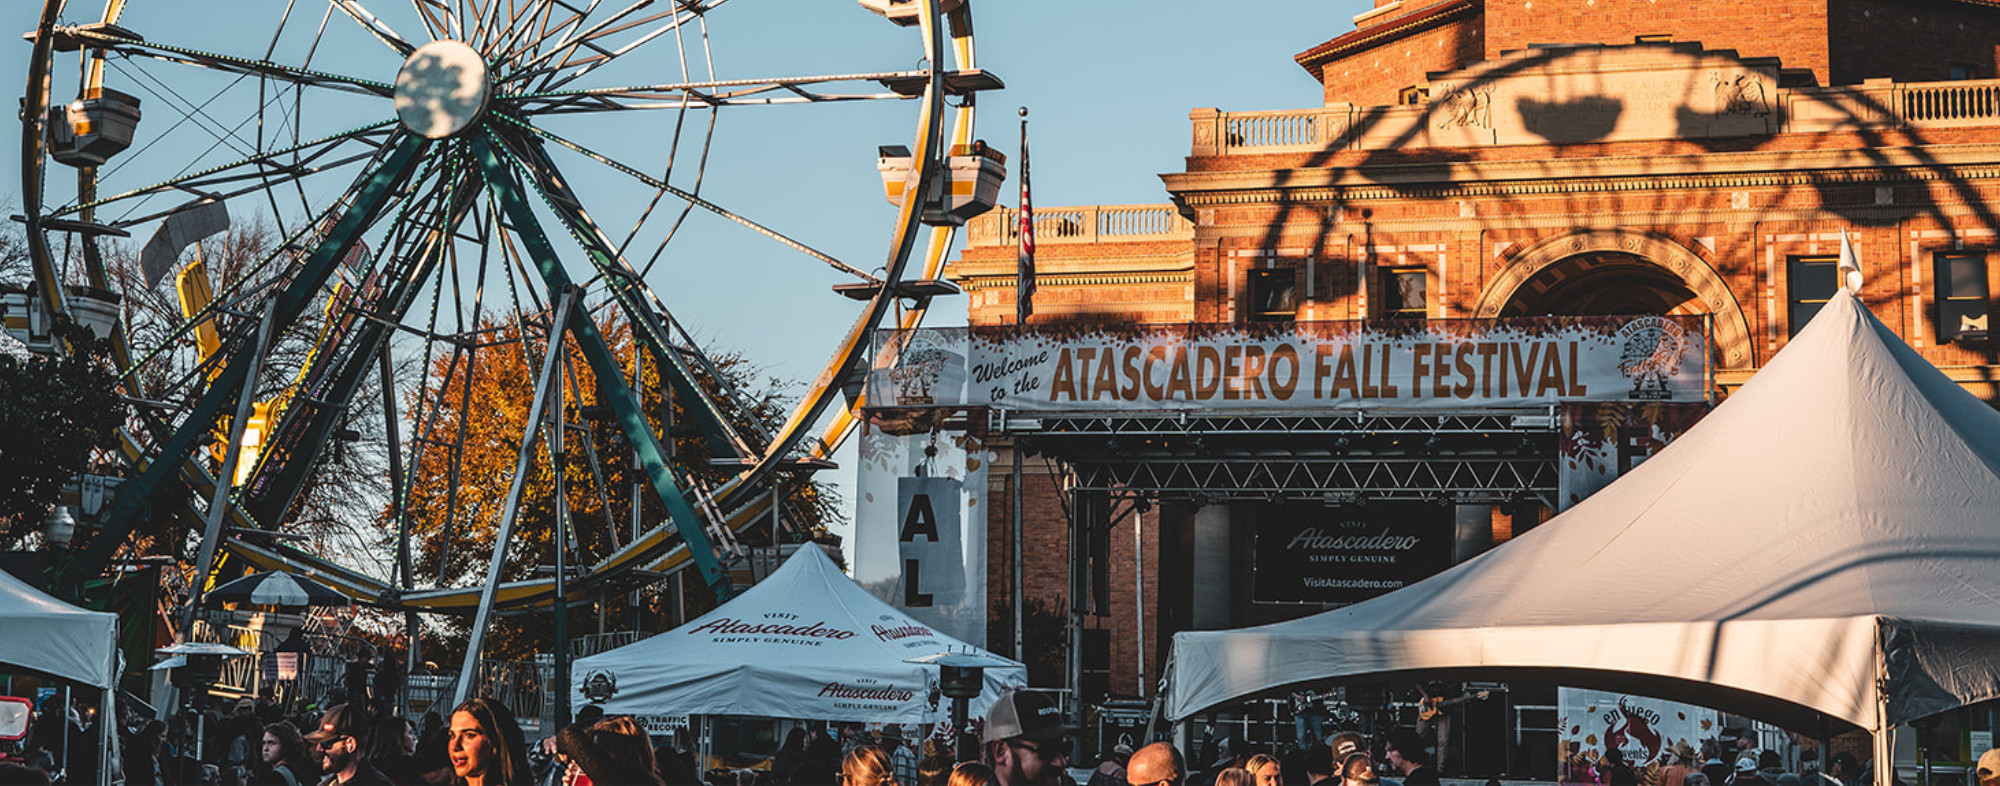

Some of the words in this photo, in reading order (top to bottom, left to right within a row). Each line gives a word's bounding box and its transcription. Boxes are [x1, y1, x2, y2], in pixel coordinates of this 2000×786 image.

[1621, 318, 1682, 339] ATASCADERO
[972, 351, 1049, 384] Welcome
[1050, 343, 1299, 401] ATASCADERO
[1314, 343, 1398, 398] FALL
[1412, 341, 1587, 399] FESTIVAL
[990, 384, 1007, 402] to
[1014, 372, 1041, 394] the
[1286, 526, 1420, 550] Atascadero
[1350, 555, 1396, 563] GENUINE
[1303, 577, 1403, 589] VisitAtascadero.com
[763, 613, 799, 621] VISIT
[688, 617, 859, 640] Atascadero
[763, 637, 823, 647] GENUINE
[817, 681, 915, 702] Atascadero
[1622, 748, 1648, 759] vents
